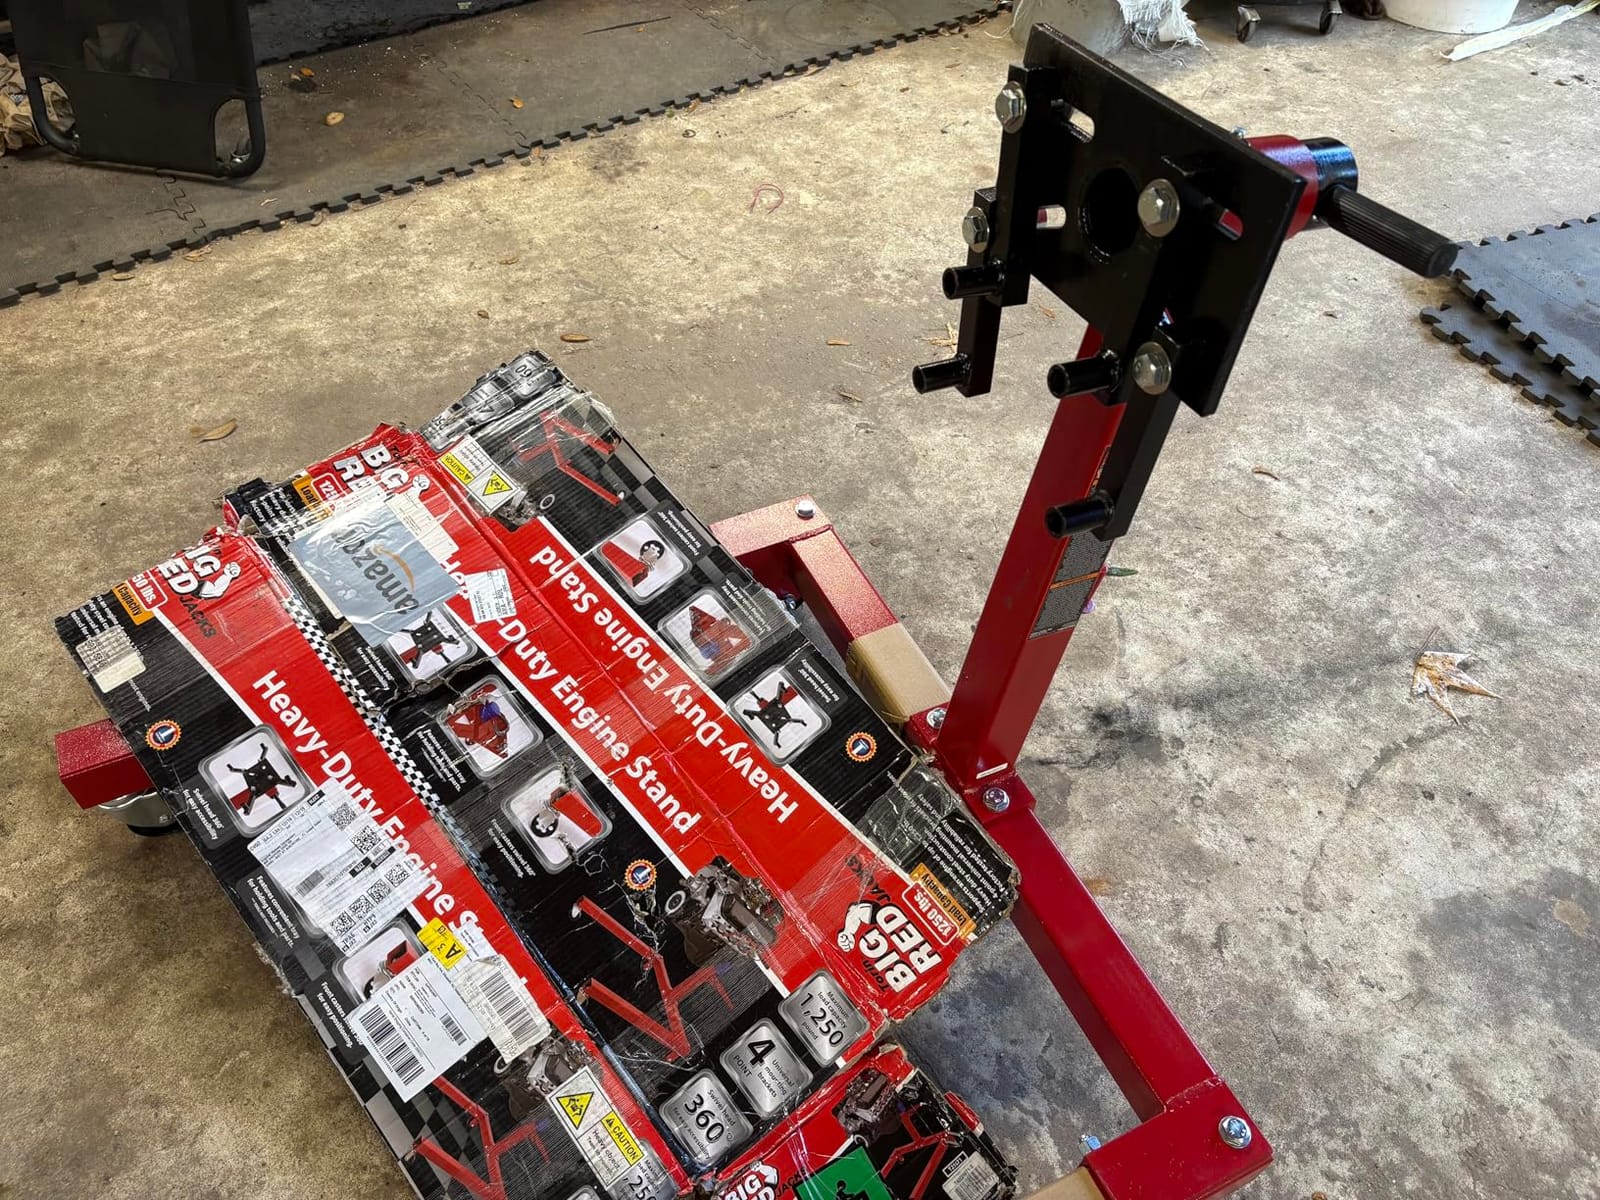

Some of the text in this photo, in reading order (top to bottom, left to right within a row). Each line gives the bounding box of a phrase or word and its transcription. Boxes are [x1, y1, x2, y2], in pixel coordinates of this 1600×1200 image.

[359, 438, 409, 493] BIG
[444, 454, 465, 476] CAUTION
[181, 541, 222, 576] IG
[686, 543, 699, 556] Front
[157, 556, 198, 594] ED
[115, 584, 145, 618] Capacity
[138, 582, 160, 605] lbs.
[177, 591, 218, 640] JACKS
[367, 662, 391, 692] accessibility
[531, 548, 799, 823] Heavy-Duty Engine Stand
[799, 657, 840, 701] for easy accessibility
[805, 675, 819, 690] head
[815, 686, 831, 703] Swivel
[252, 671, 383, 826] Heavy-Duty
[552, 672, 630, 762] Engine
[626, 756, 700, 834] Stand
[448, 776, 462, 792] parts.
[455, 772, 466, 785] tray
[182, 788, 219, 841] for easy accessibility
[192, 787, 208, 806] Swivel
[203, 802, 217, 819] head
[489, 817, 503, 833] Front
[499, 831, 515, 850] casters
[511, 848, 527, 866] swivel
[920, 839, 929, 848] to
[933, 825, 961, 855] mounting
[939, 817, 966, 847] reliability
[486, 827, 525, 879] for easy positioning.
[926, 845, 937, 855] up
[931, 852, 941, 863] of
[962, 843, 973, 855] for
[969, 852, 989, 872] tested
[920, 825, 994, 906] Heavy duty steel construction.
[937, 858, 960, 882] engine
[956, 851, 982, 879] universal
[985, 868, 1007, 892] Factory
[246, 877, 256, 888] for
[250, 885, 270, 909] holding
[978, 875, 1001, 899] 4-point
[255, 875, 275, 899] Features
[270, 897, 293, 928] convenient
[288, 926, 301, 940] tray
[909, 888, 953, 937] 1250 lbs.
[918, 871, 968, 926] Load Capacity
[960, 884, 988, 913] Supports
[265, 906, 279, 922] tools
[274, 920, 285, 932] and
[280, 930, 295, 948] parts.
[445, 945, 462, 961] A
[870, 900, 943, 977] RED
[854, 926, 918, 994] BIG
[859, 957, 890, 992] Torin
[320, 981, 347, 1018] Front casters
[816, 991, 848, 1030] load capacity
[825, 990, 850, 1020] Maximum
[315, 992, 355, 1049] for easy positioning.
[794, 991, 846, 1049] 1,250
[801, 1020, 818, 1040] pound
[740, 1031, 779, 1069] 4
[732, 1054, 752, 1078] POINT
[771, 1058, 794, 1087] Universal
[757, 1071, 778, 1097] brackets
[707, 1088, 736, 1126] Swivel head
[591, 1129, 607, 1150] Heavy
[611, 1124, 638, 1160] CAUTION
[686, 1127, 712, 1160] accessibility
